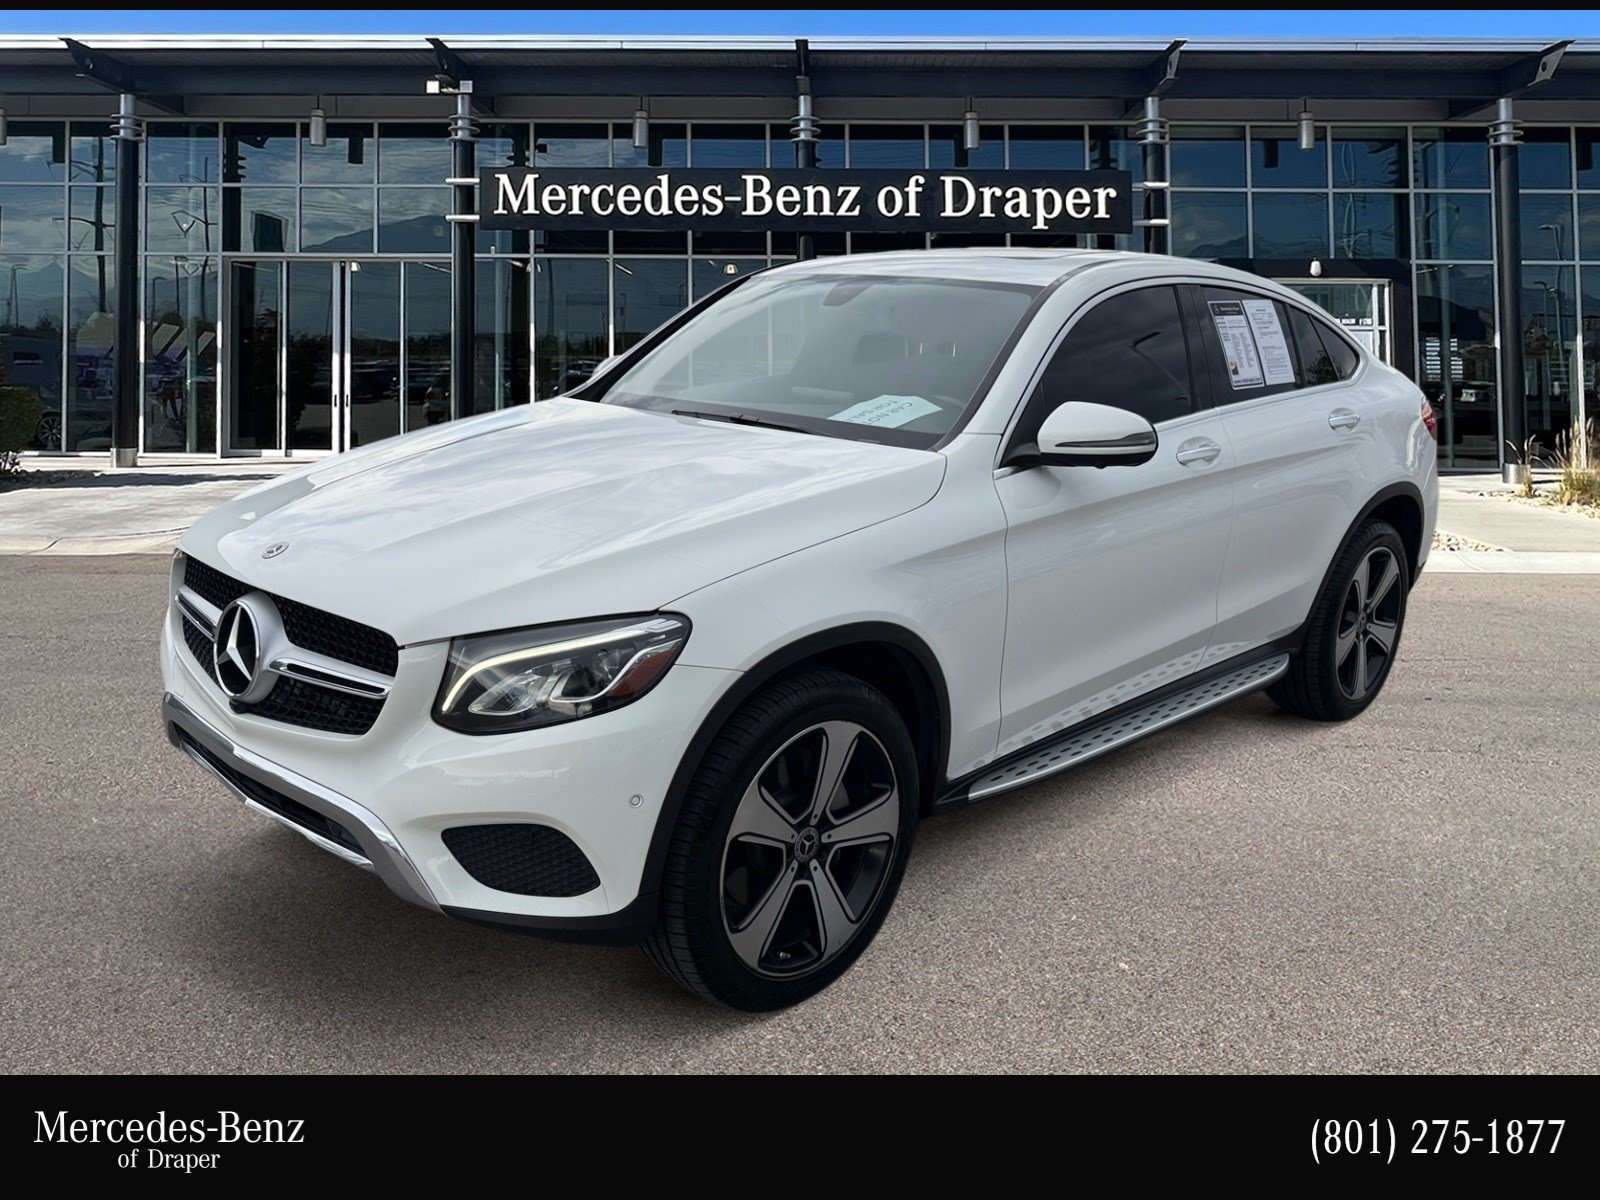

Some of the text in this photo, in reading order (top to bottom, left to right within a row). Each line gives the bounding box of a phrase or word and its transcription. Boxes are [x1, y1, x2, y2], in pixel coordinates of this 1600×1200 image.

[493, 173, 1117, 231] Mercedes-Benz of Draper
